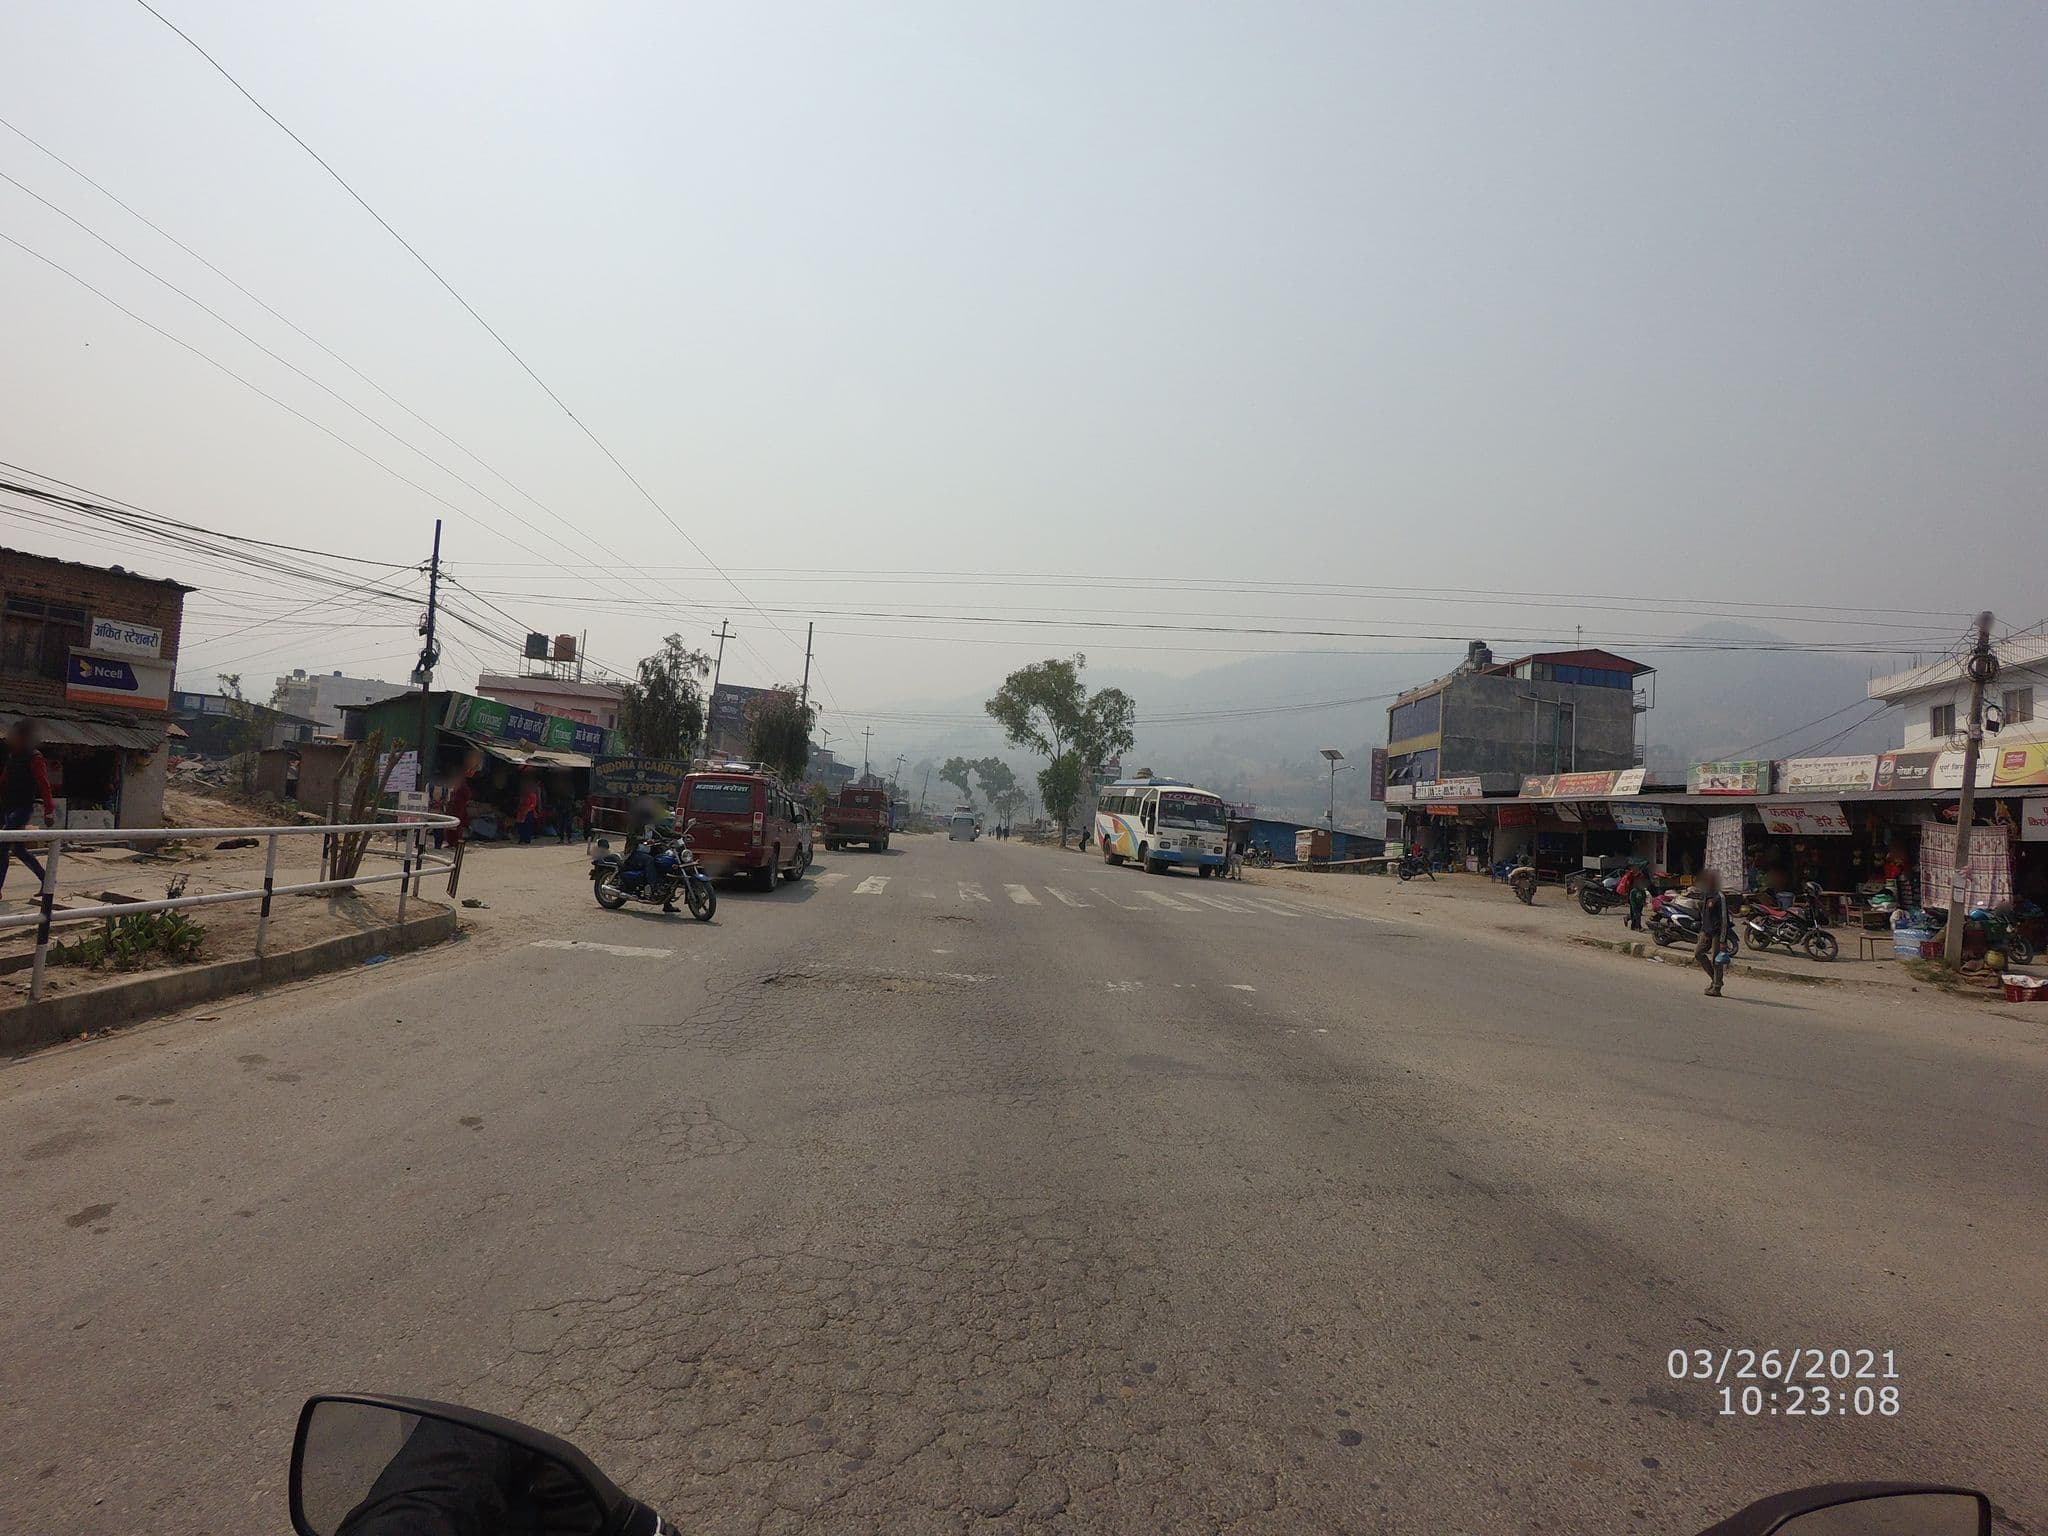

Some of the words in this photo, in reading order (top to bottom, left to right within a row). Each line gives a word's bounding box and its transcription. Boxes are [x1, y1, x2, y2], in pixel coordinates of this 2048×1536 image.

[93, 622, 122, 641] अंकित
[124, 628, 160, 648] स्टेशनरी
[94, 665, 123, 679] Ncell
[595, 760, 635, 776] BUDDHA
[637, 760, 686, 777] ACADEMY
[1768, 808, 1807, 821] फलफूल
